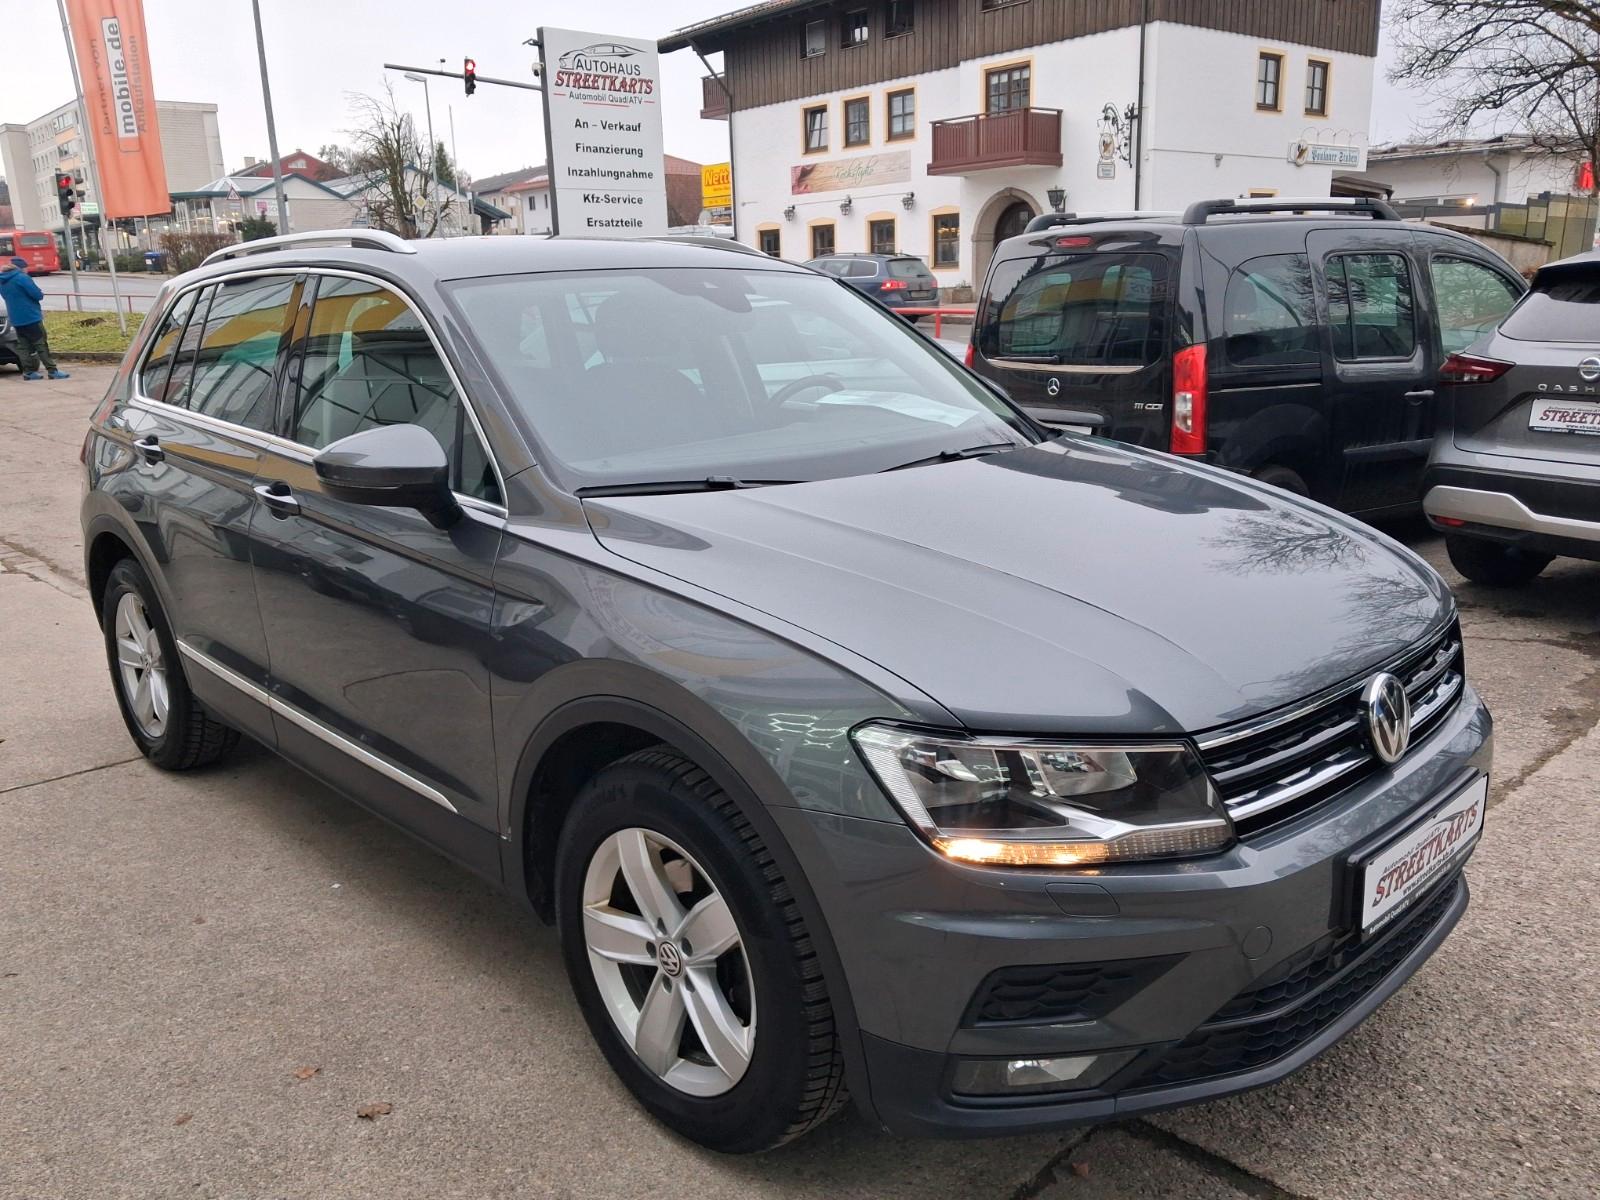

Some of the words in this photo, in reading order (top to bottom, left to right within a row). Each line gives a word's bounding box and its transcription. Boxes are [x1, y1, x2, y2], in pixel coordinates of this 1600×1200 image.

[89, 38, 101, 69] von
[575, 58, 641, 76] AUTOHAUS
[107, 22, 136, 134] mobile.de
[128, 35, 146, 133] Ankaufstation
[554, 70, 654, 94] STREETKARTS
[569, 91, 607, 102] Automobil
[574, 118, 589, 129] An
[600, 119, 641, 132] Verkauf
[575, 142, 644, 158] Finanzierung
[567, 166, 654, 180] Inzahlungnahme
[583, 193, 644, 205] Kfz-Service
[587, 217, 644, 228] Ersatzteile
[1539, 408, 1600, 425] STREET
[1372, 800, 1480, 907] STREETKARTS
